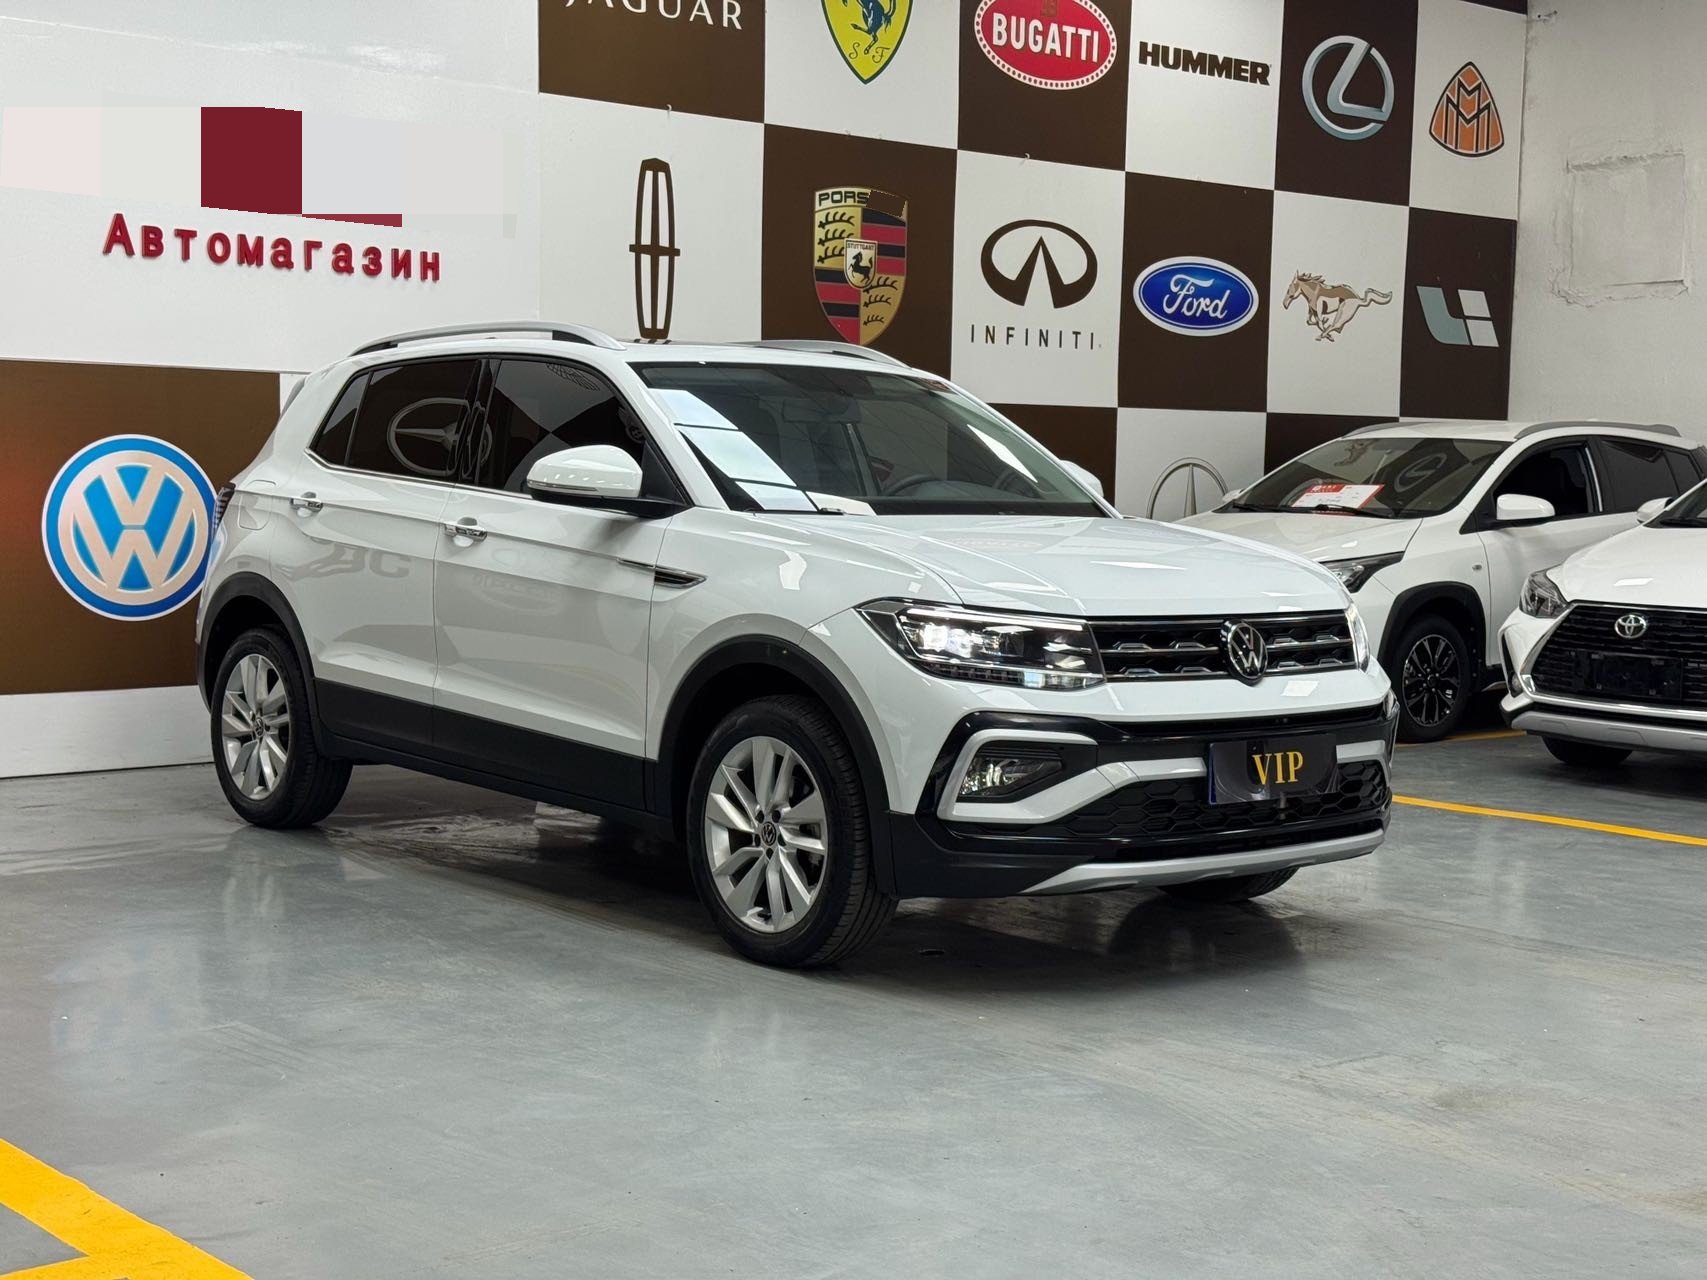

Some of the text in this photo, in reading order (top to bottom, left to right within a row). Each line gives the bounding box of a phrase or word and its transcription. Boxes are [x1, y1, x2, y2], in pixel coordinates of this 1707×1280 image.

[992, 12, 1100, 63] BUGATTI
[1139, 41, 1270, 86] HUMMER
[818, 190, 870, 207] PORS
[102, 213, 440, 282] Автомагазин
[1162, 273, 1231, 319] Ford
[970, 323, 1095, 350] INFINITI
[1252, 751, 1304, 785] VIP
